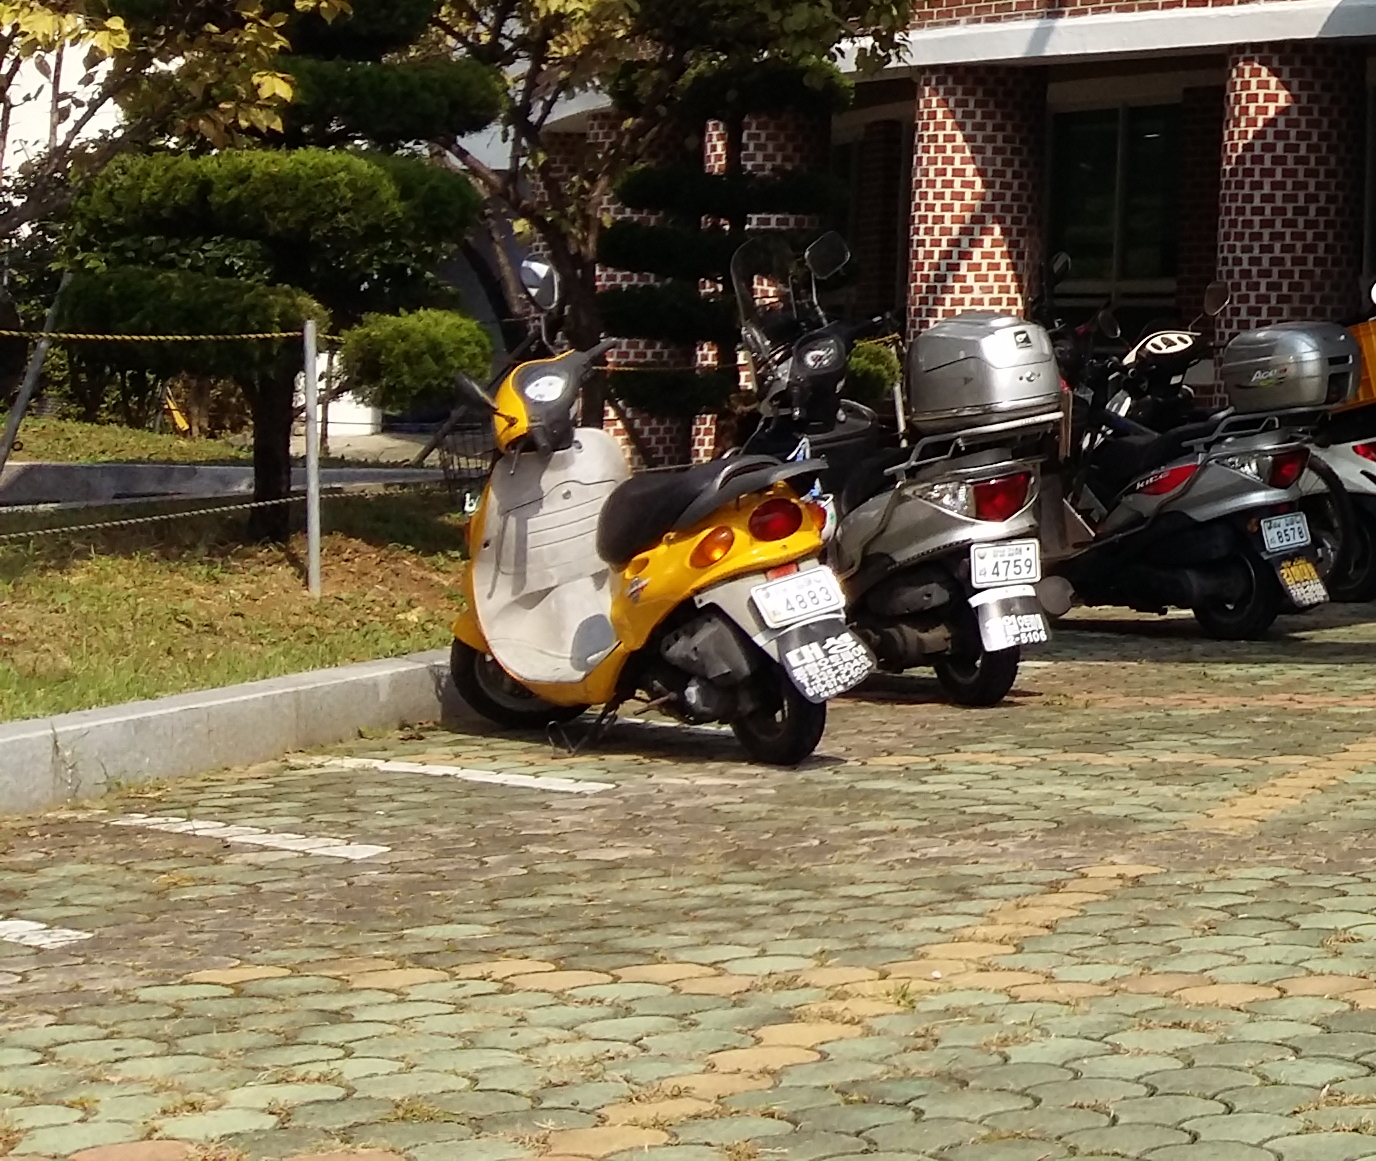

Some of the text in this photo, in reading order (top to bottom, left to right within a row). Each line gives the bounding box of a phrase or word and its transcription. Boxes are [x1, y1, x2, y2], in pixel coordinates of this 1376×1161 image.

[991, 558, 1033, 578] 4759
[784, 586, 832, 613] 4883
[786, 632, 857, 668] 대성
